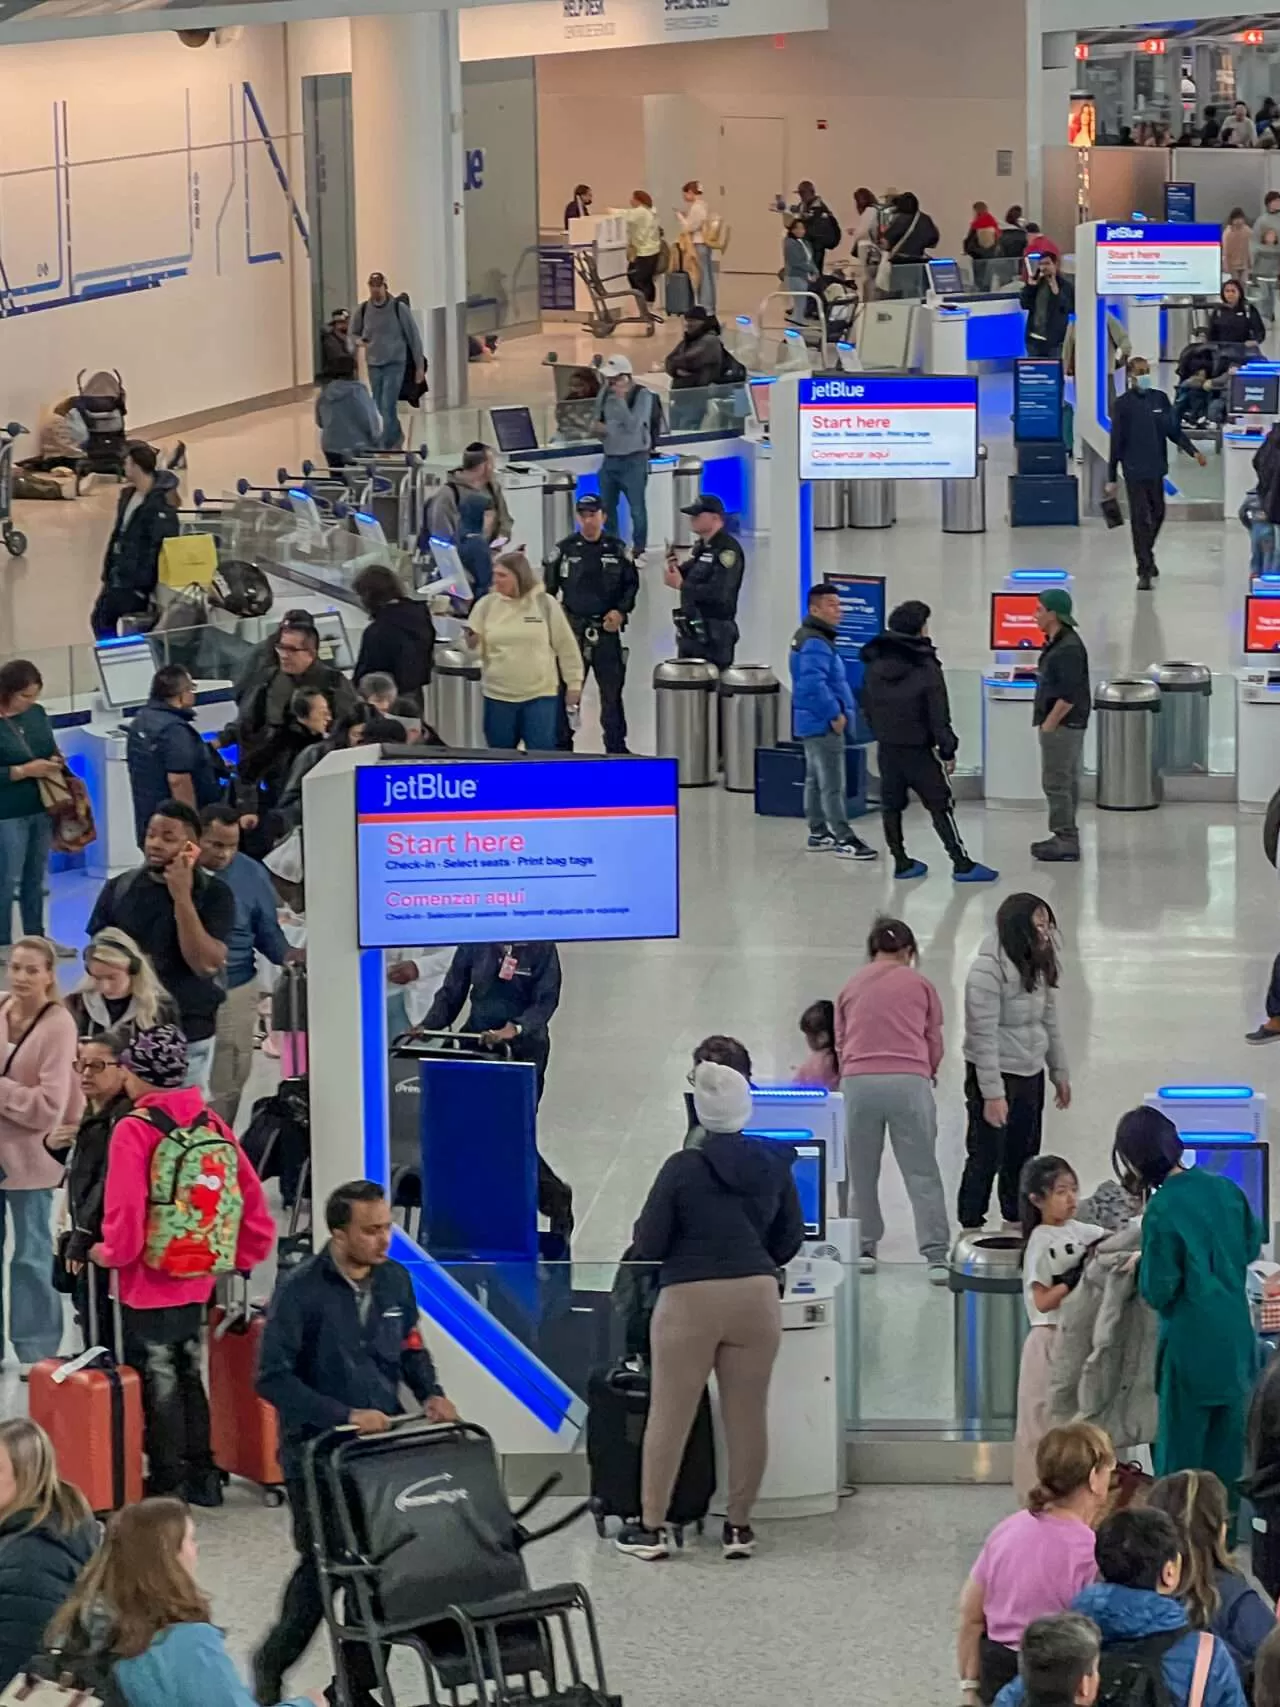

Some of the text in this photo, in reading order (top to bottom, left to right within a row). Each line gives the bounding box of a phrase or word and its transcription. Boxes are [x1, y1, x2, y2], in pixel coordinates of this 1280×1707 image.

[1106, 226, 1144, 241] jetBlue
[1107, 249, 1134, 259] Start
[811, 381, 865, 401] jetBlue
[812, 415, 890, 429] Start here
[811, 450, 864, 459] Comenzar
[383, 773, 478, 807] jetBlue
[386, 831, 524, 856] Start here
[385, 856, 594, 870] Check-in Select seats Print bag tags
[385, 891, 480, 907] Comenzar
